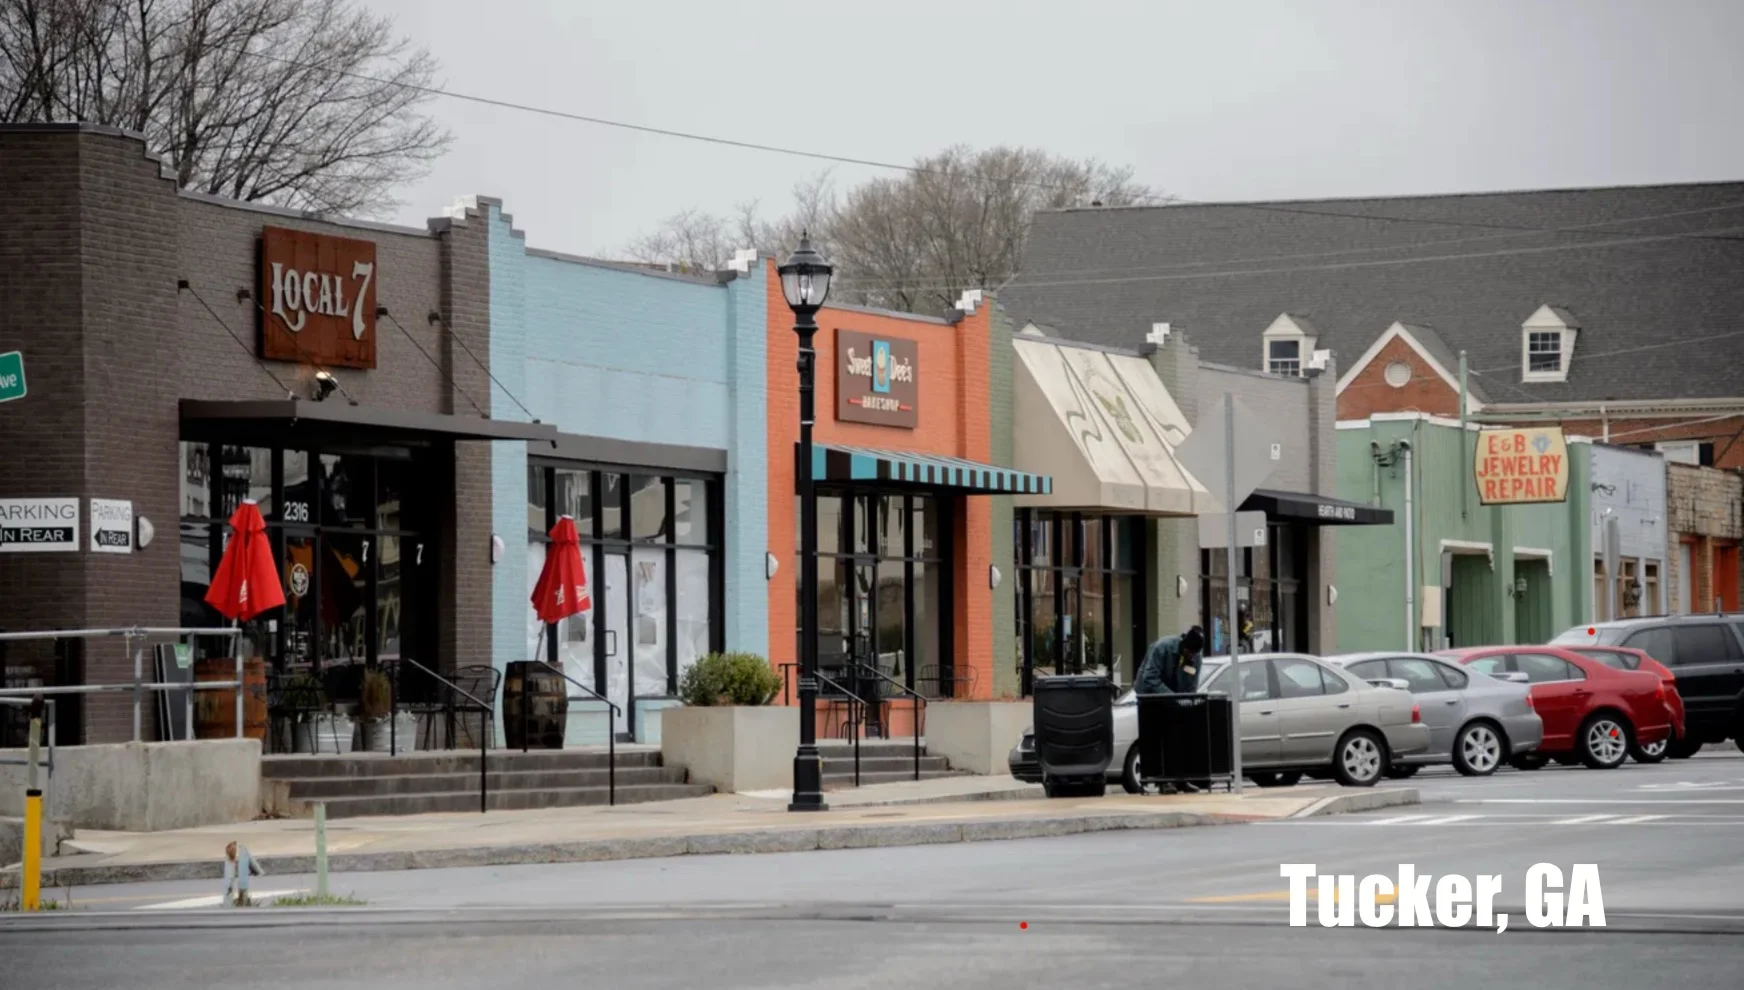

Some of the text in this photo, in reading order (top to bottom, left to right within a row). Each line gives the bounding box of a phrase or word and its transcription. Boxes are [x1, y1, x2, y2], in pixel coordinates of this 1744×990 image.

[271, 260, 374, 340] LOCAL 7
[847, 347, 913, 382] Sweet Dee's
[1478, 454, 1562, 478] JEWELRY
[1485, 477, 1557, 500] REPAIR
[91, 501, 131, 521] PARKING
[284, 501, 309, 521] 2316
[0, 528, 65, 541] IN REAR
[108, 530, 127, 545] REAR
[362, 540, 370, 563] 7
[416, 543, 424, 566] 7
